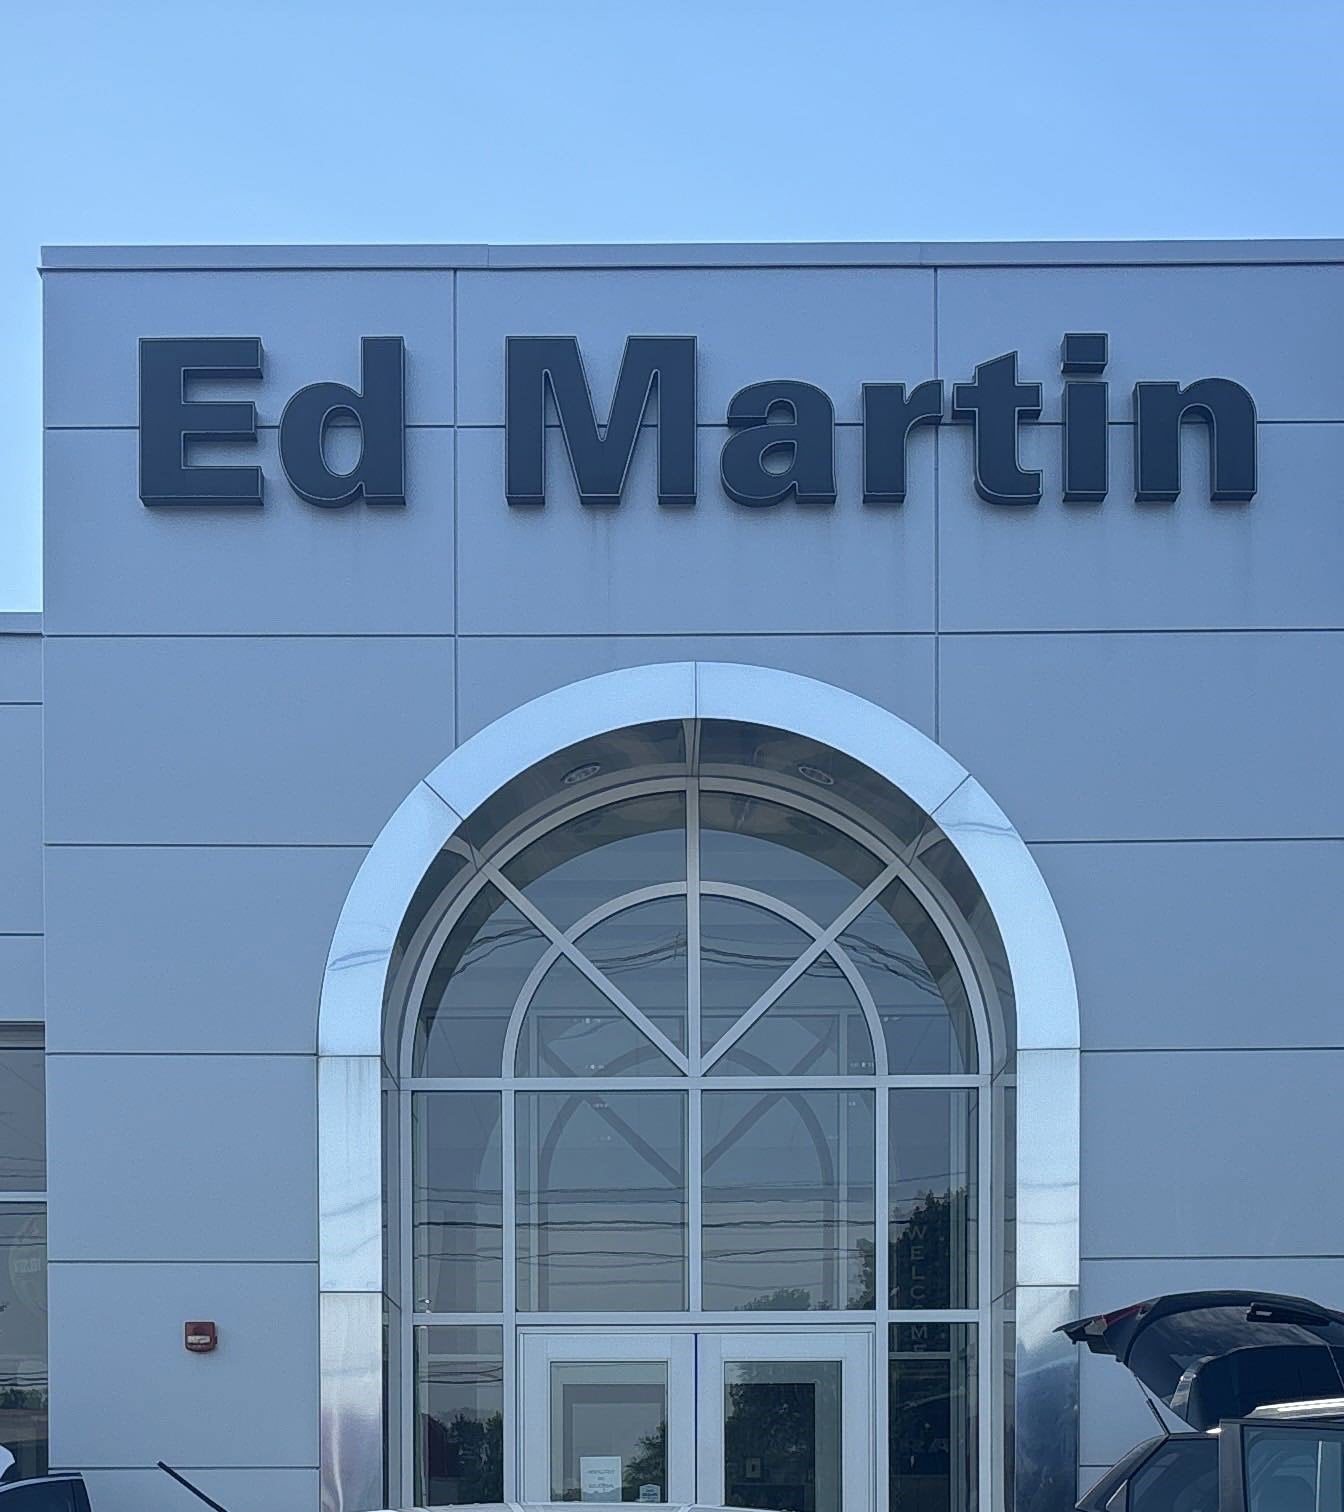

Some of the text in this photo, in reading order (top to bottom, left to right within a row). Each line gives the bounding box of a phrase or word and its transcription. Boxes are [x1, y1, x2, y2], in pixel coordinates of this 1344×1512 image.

[139, 333, 1258, 507] Ed Martin
[906, 1225, 929, 1353] WELCME
